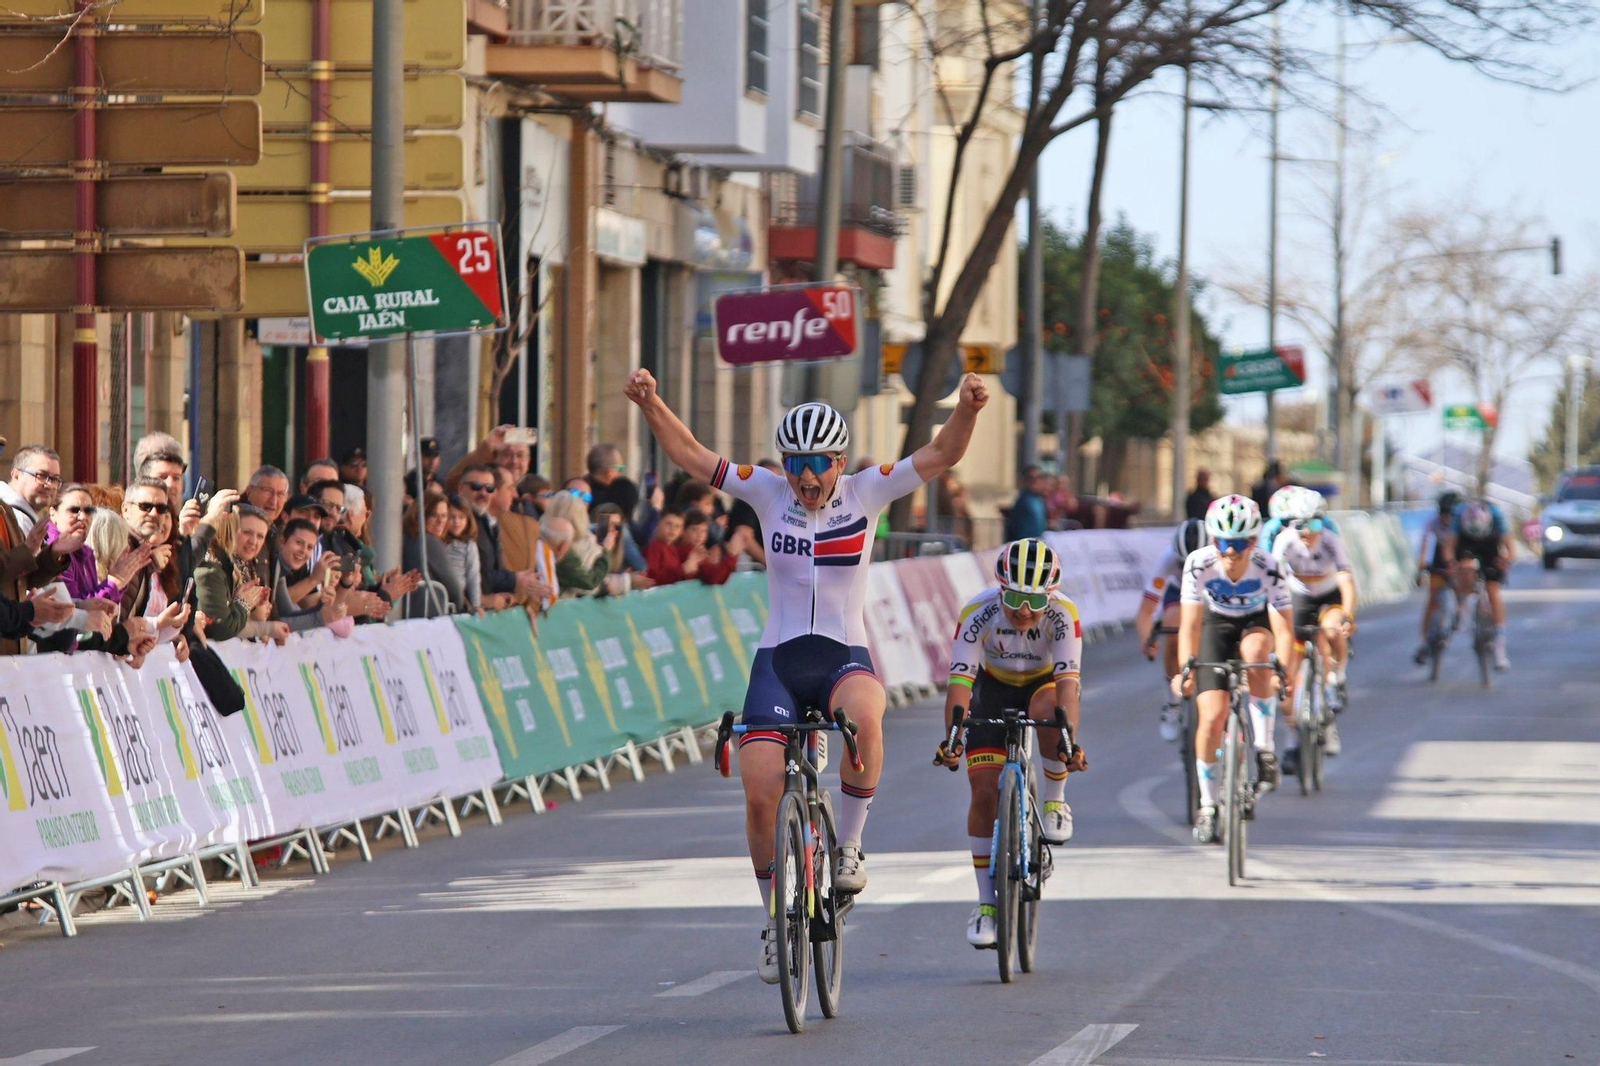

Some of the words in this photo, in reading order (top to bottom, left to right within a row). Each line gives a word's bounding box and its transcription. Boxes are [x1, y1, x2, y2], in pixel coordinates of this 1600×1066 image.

[456, 236, 491, 274] 25
[323, 294, 371, 314] CAJA
[374, 288, 440, 310] RURAL
[821, 290, 851, 320] 50
[358, 309, 405, 331] JAÉN
[726, 307, 829, 350] renfe
[771, 531, 812, 557] GBR
[963, 602, 1000, 644] Cofidis
[1000, 651, 1042, 661] Cofidis
[247, 667, 303, 761] Jaén
